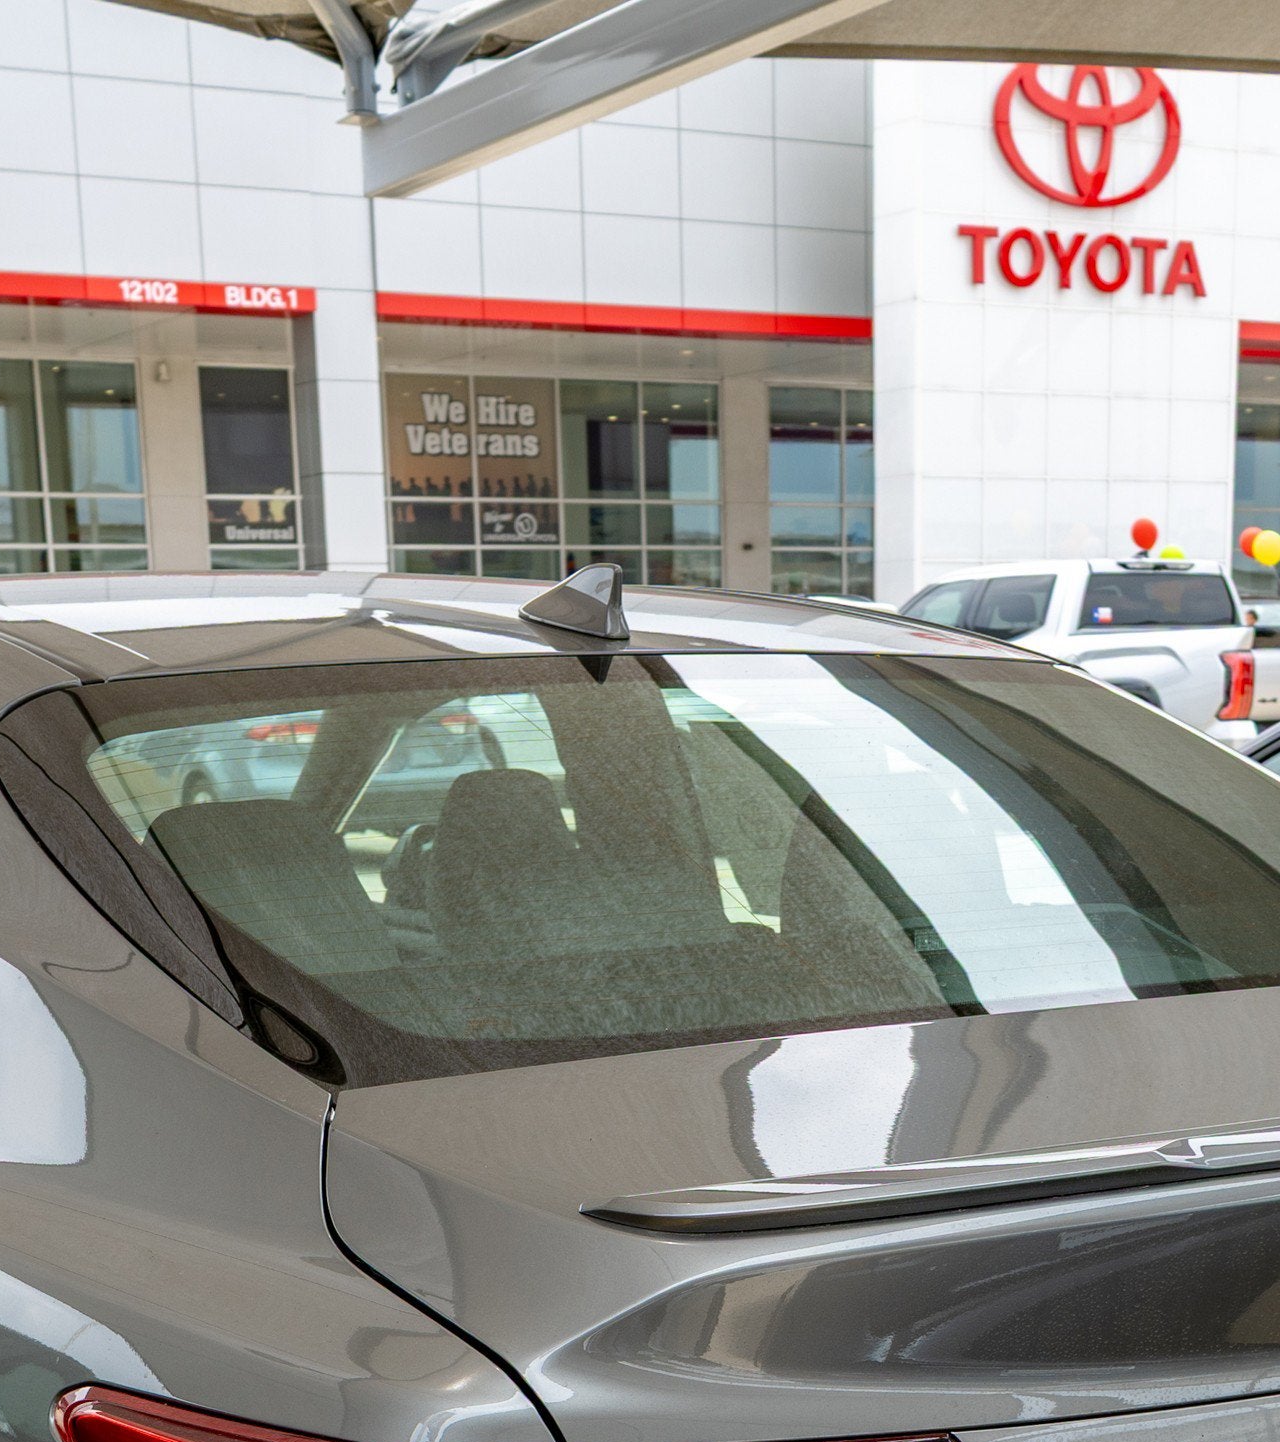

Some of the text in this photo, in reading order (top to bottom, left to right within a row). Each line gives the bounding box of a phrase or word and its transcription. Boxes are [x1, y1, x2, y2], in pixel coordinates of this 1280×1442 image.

[958, 224, 1207, 298] TOYOTA
[119, 280, 178, 304] 12102
[422, 393, 536, 426] We Hire
[405, 424, 539, 457] Veterans
[225, 525, 295, 541] Universal
